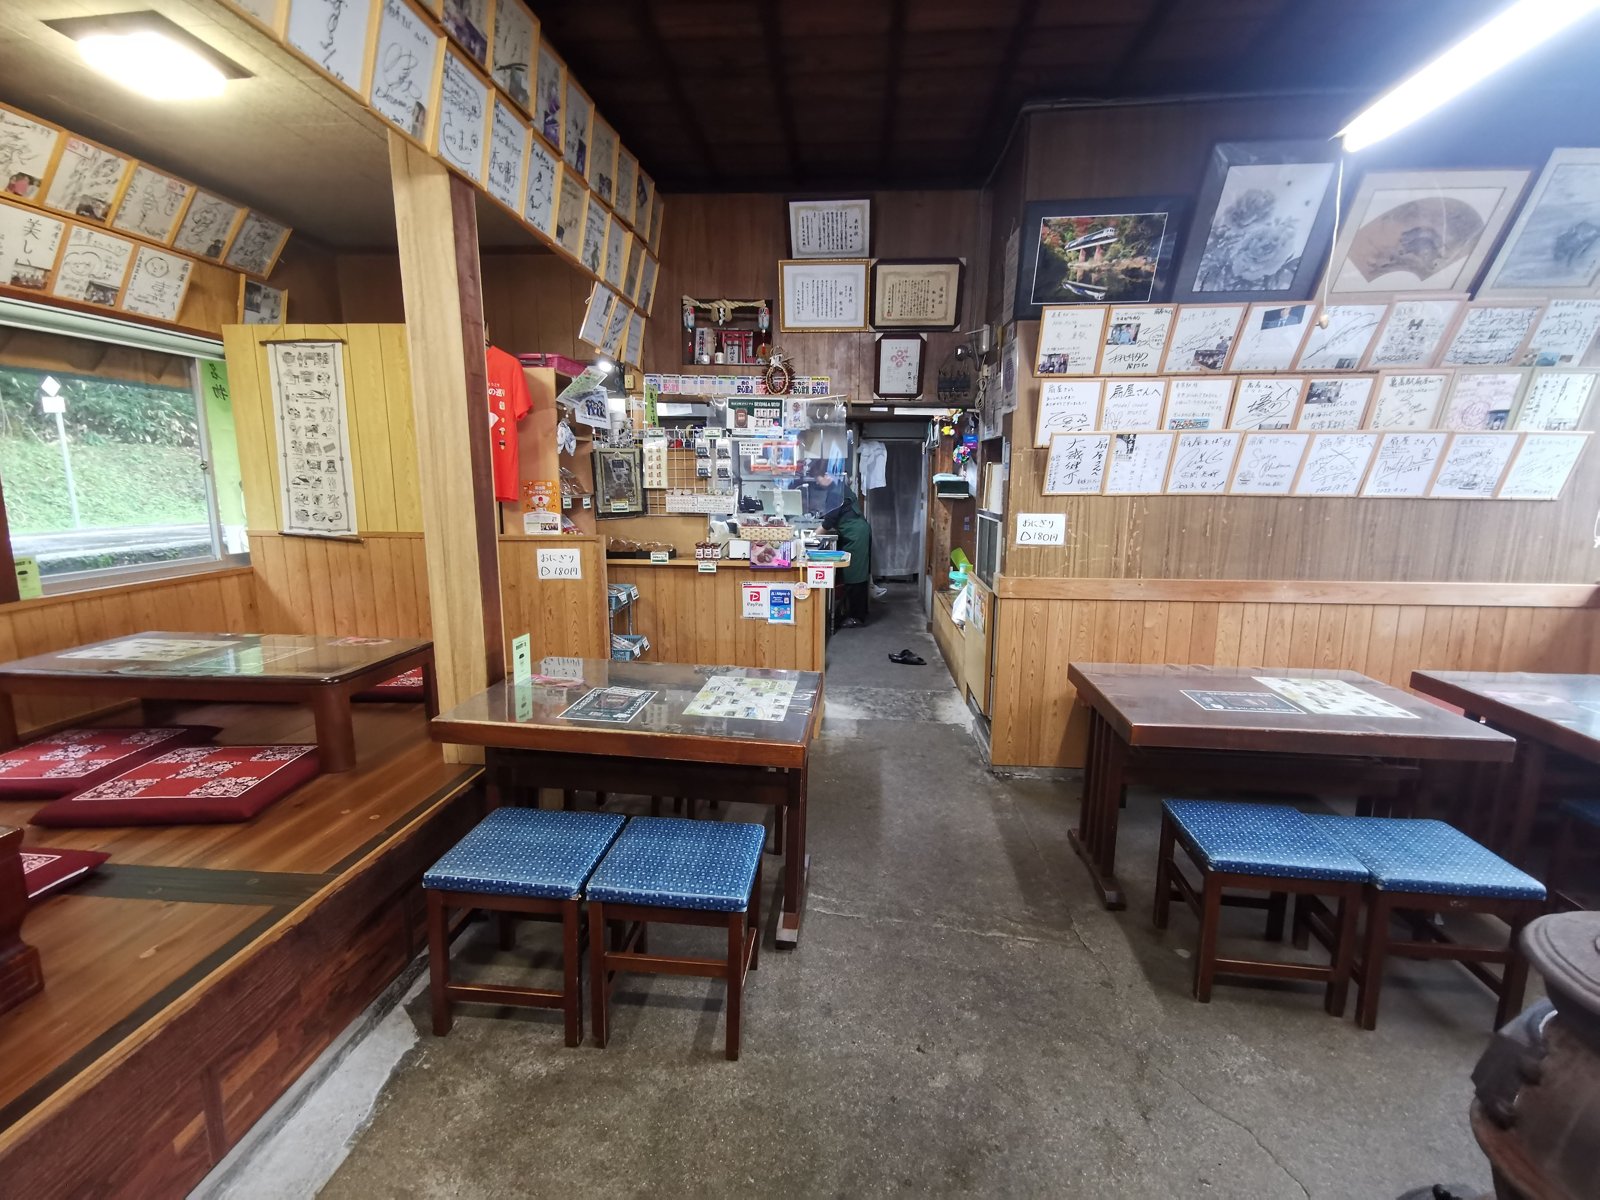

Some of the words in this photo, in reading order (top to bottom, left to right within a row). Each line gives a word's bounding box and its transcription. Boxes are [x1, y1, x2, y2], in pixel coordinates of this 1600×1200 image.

[1110, 384, 1161, 399] 扇屋さんへ
[1022, 519, 1054, 528] おにぎり
[541, 554, 574, 563] おにぎり
